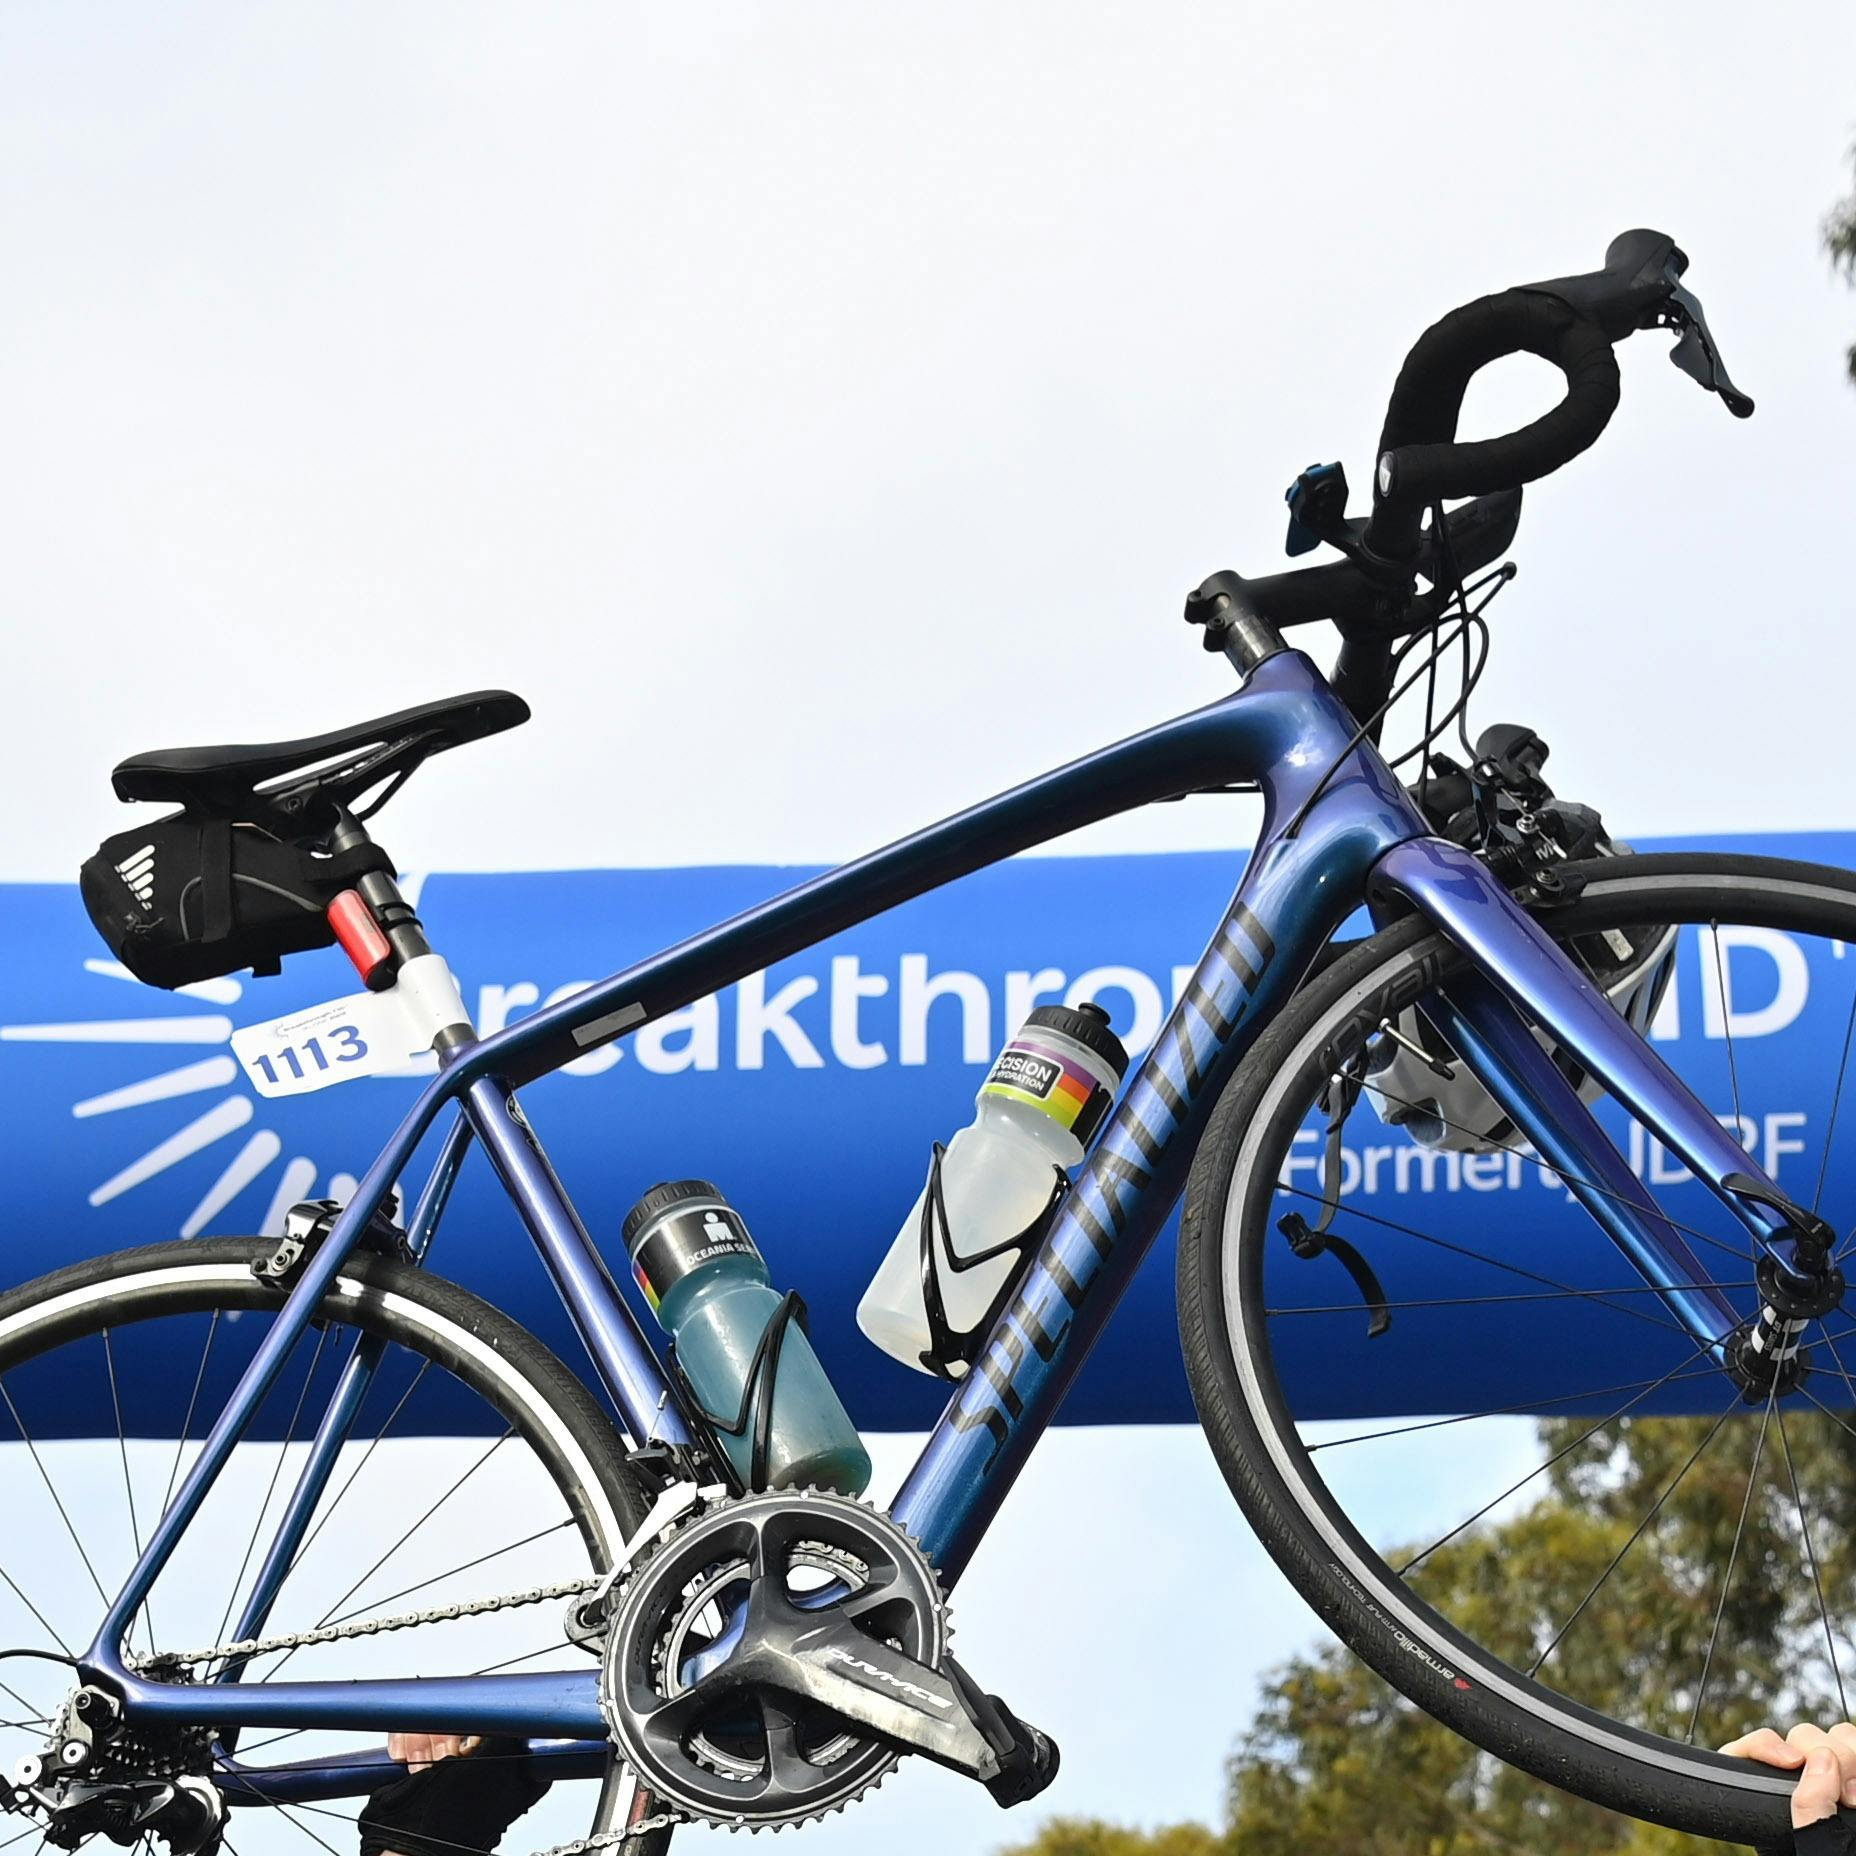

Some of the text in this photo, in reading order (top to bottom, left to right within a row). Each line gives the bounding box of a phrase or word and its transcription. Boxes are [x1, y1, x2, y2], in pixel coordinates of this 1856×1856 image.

[252, 1025, 368, 1083] 1113
[950, 900, 1276, 1474] SPECIALIZED
[686, 1244, 735, 1267] OCEANIA
[1328, 1563, 1366, 1604] TECHNOLOGY
[1393, 1630, 1456, 1680] armadillo
